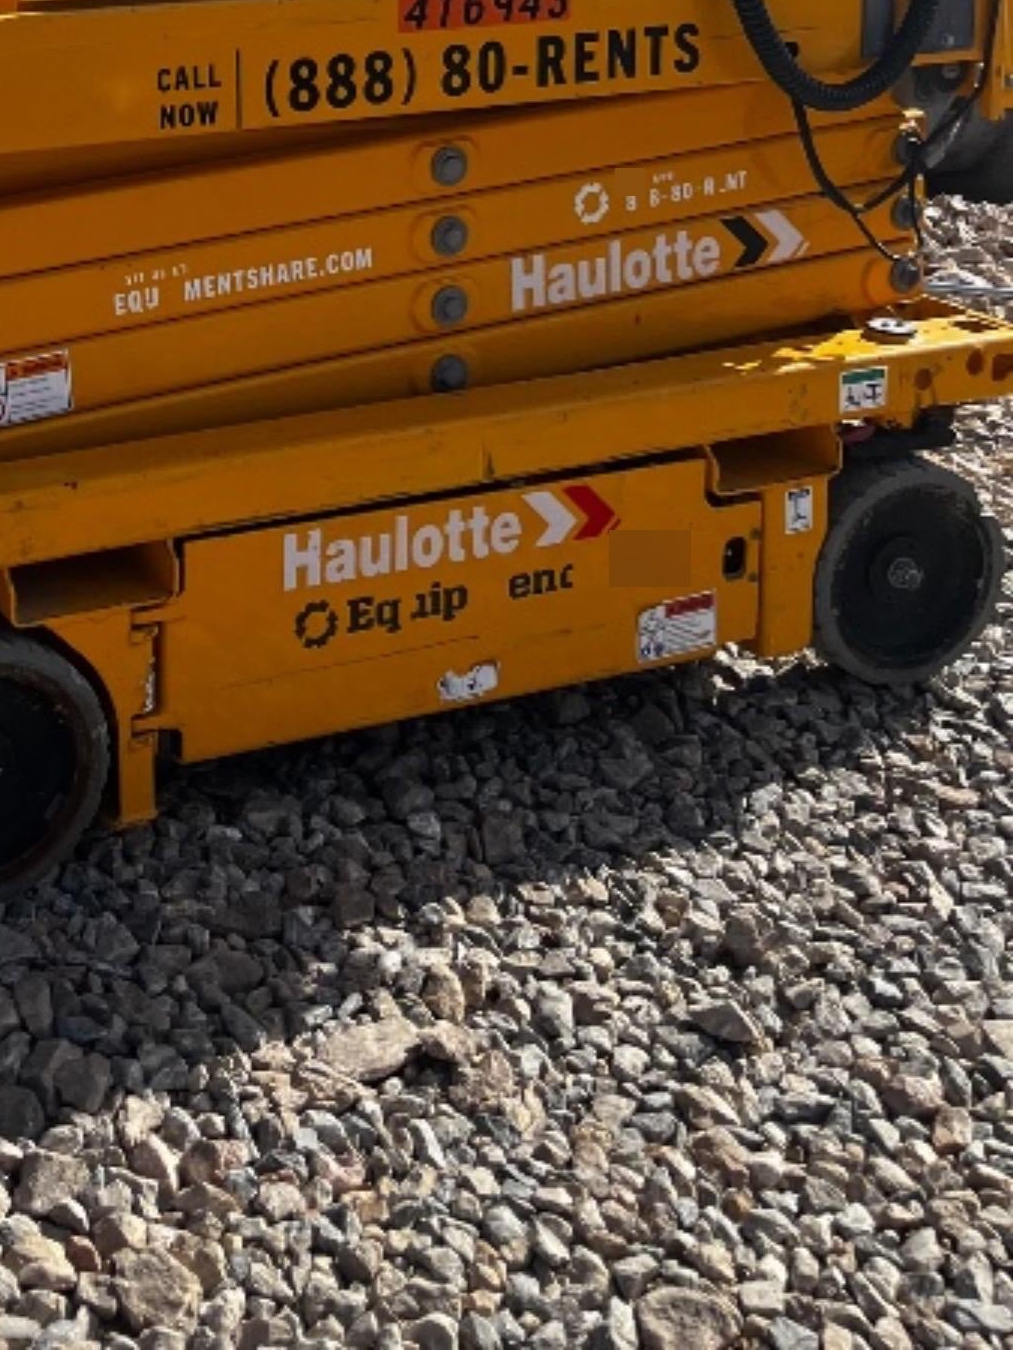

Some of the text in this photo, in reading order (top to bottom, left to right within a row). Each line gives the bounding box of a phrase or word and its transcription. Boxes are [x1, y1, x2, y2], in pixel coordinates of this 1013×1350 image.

[157, 62, 222, 93] CALL
[265, 23, 700, 118] (888) 80-RENTS
[159, 102, 219, 129] NOW
[113, 248, 373, 316] EQUMENTSHARE.COM
[510, 230, 721, 312] Haulotte
[282, 506, 523, 591] Haulotte
